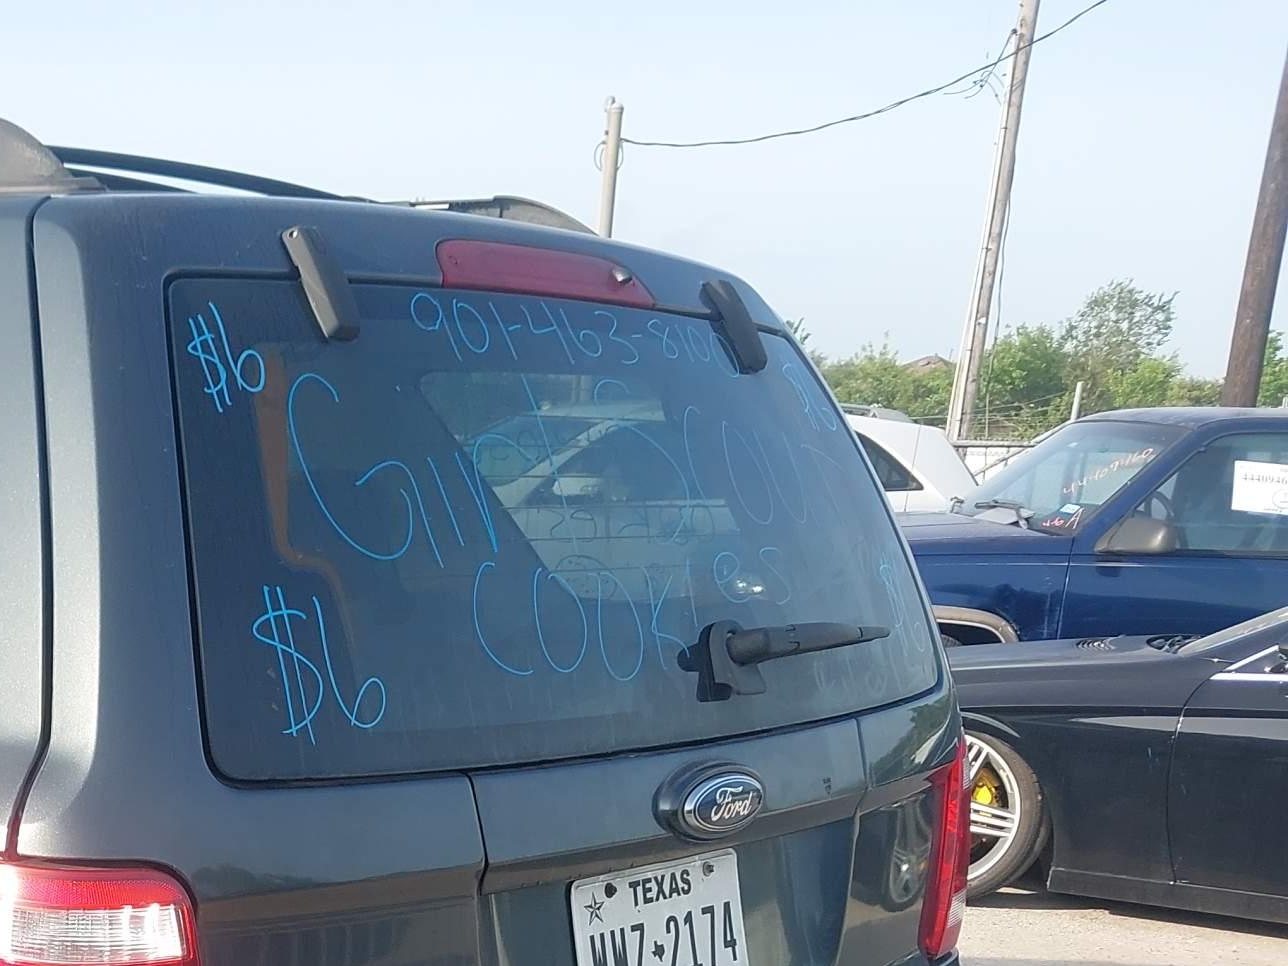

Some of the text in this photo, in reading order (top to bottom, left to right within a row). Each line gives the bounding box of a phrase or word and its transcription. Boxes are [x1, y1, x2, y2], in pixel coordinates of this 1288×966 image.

[188, 303, 265, 413] $6
[252, 585, 386, 746] $6
[710, 784, 754, 823] Ford
[628, 868, 692, 908] TEXAS
